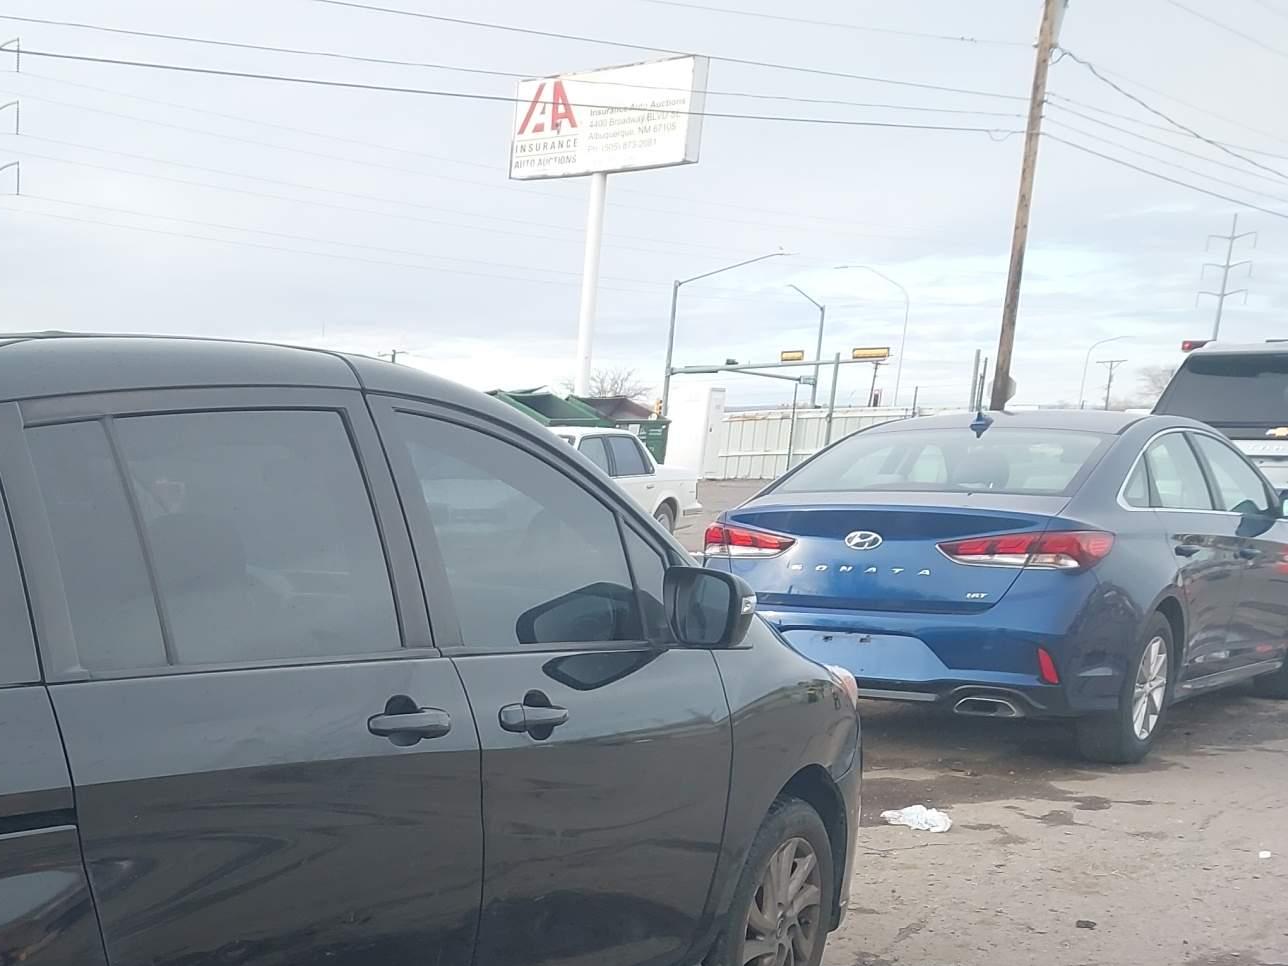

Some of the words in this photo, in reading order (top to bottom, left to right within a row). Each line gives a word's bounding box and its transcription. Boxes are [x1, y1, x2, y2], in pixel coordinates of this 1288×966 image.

[650, 97, 687, 109] Auctions
[515, 138, 577, 153] INSURANCE
[514, 158, 536, 169] AUTO
[537, 154, 577, 168] AUCTIONS
[791, 563, 931, 576] SONATA
